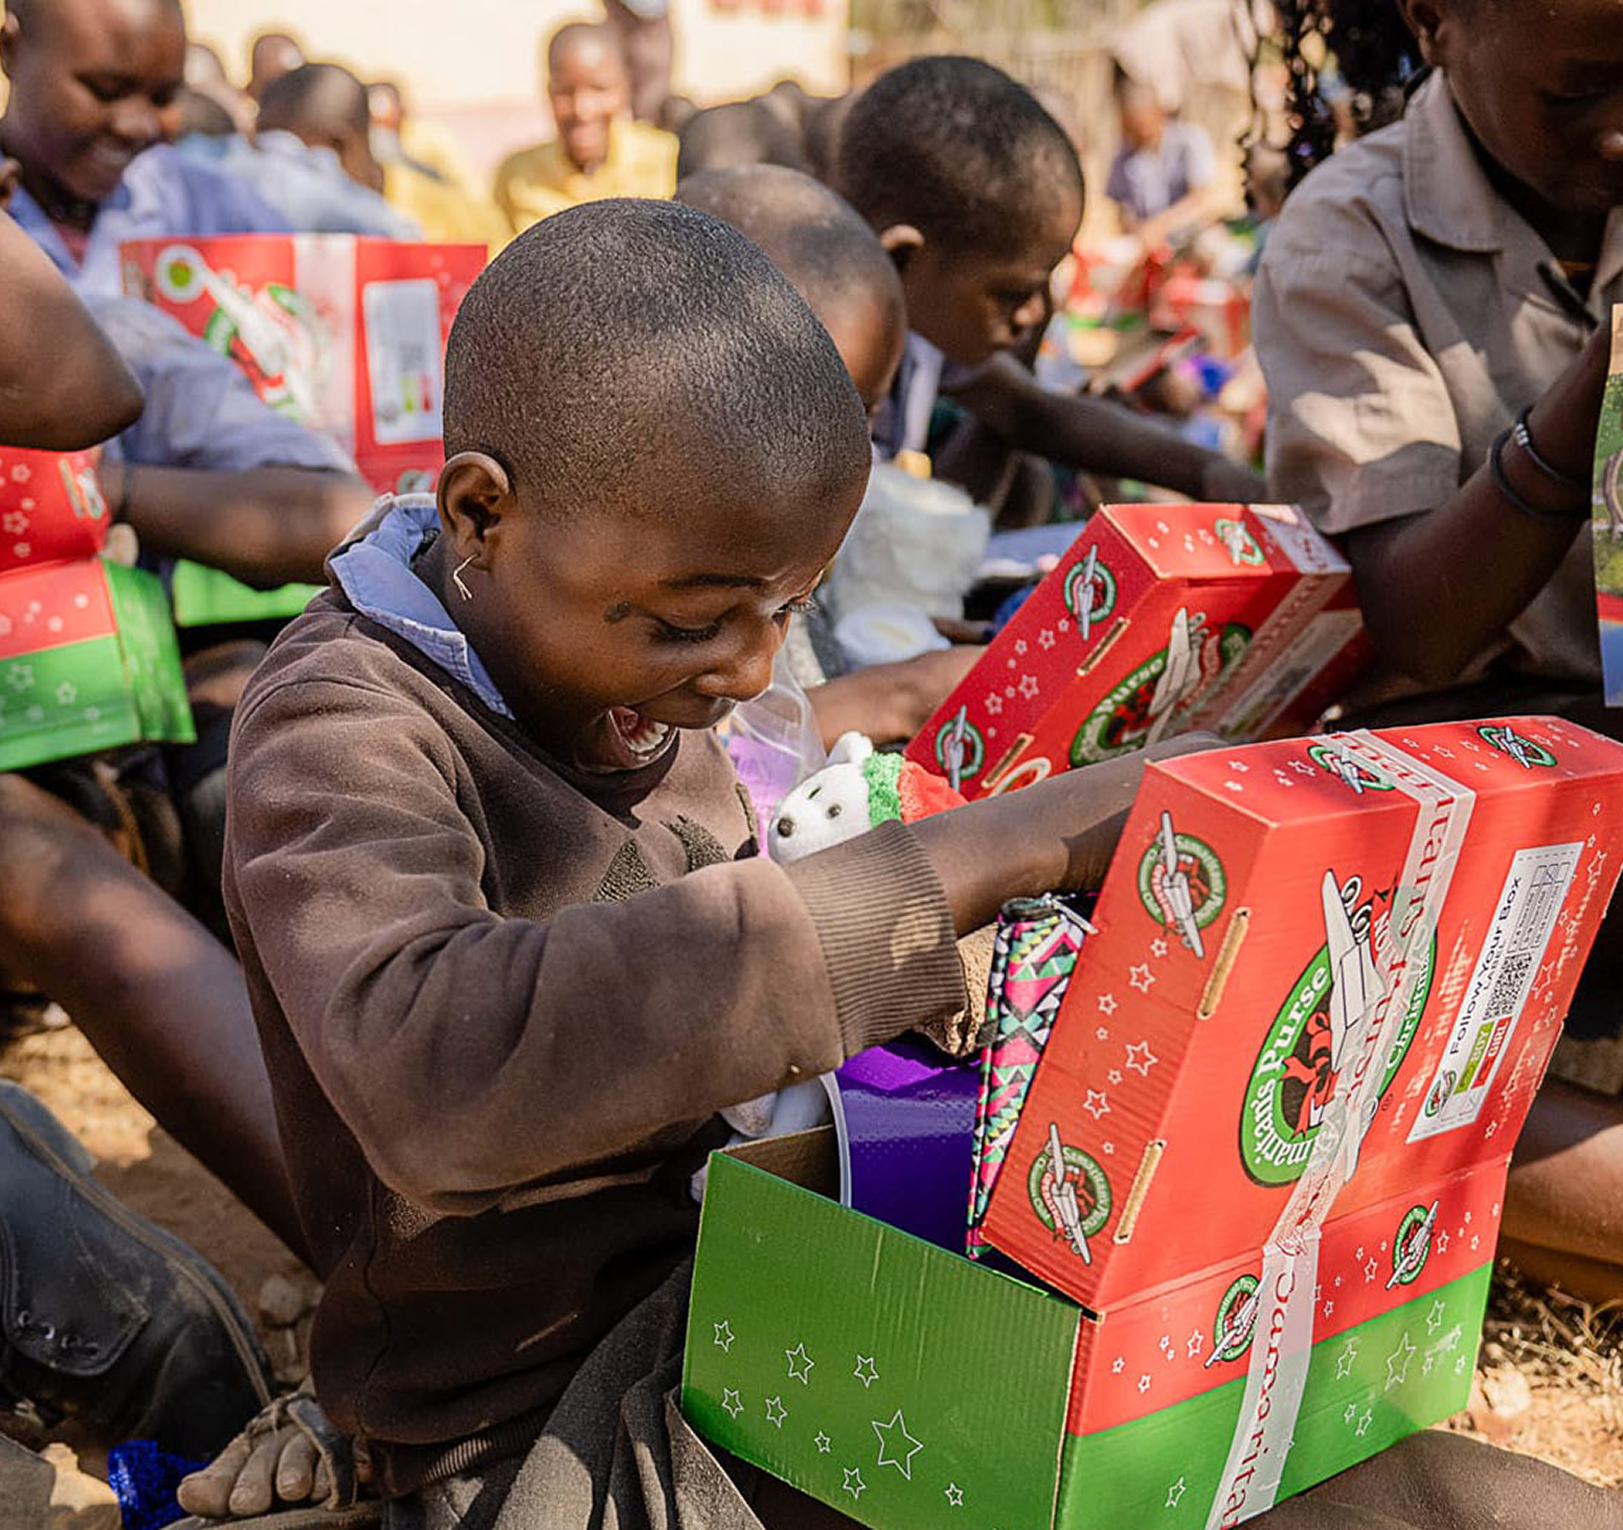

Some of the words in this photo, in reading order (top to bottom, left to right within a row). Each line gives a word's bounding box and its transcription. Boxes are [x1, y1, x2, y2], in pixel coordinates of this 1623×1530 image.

[1450, 980, 1483, 1055] Follow
[1477, 926, 1503, 979] Your
[1498, 875, 1523, 921] Box
[1256, 966, 1328, 1077] Purse
[1487, 1020, 1510, 1058] GIRL
[1250, 1077, 1316, 1167] maritan's
